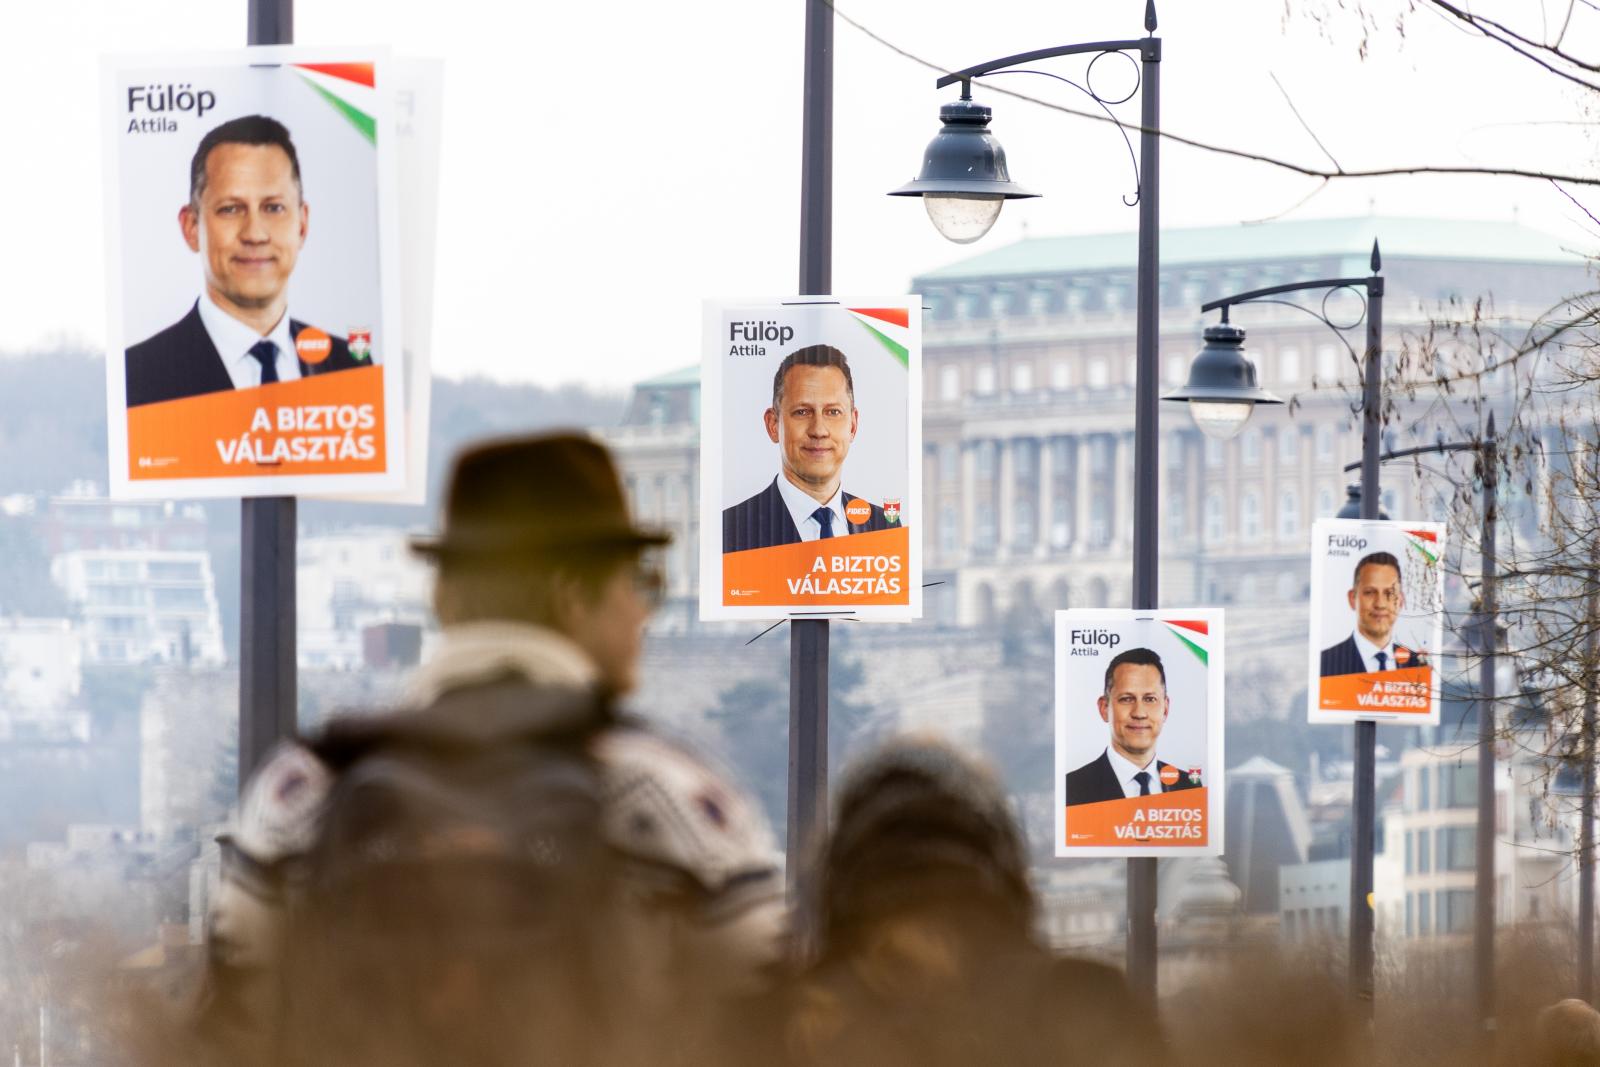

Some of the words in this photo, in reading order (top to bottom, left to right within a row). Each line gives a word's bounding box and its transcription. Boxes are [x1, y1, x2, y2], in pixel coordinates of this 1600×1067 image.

[127, 84, 216, 117] Fülöp
[127, 118, 178, 135] Attila
[730, 320, 794, 345] Fülöp
[729, 344, 766, 356] Attila
[251, 406, 272, 432] A
[277, 404, 376, 432] BIZTOS
[216, 430, 376, 464] VÁLASZTÁS
[847, 507, 870, 515] FIDESZ
[1328, 534, 1368, 551] Fülöp
[812, 556, 827, 573] A
[831, 555, 901, 573] BIZTOS
[787, 573, 901, 595] VÁLASZTÁS
[1071, 629, 1121, 649] Fülöp
[1070, 648, 1099, 657] Attila
[1133, 809, 1145, 822] A
[1148, 808, 1202, 822] BIZTOS
[1114, 822, 1202, 839] VÁLASZTÁS
